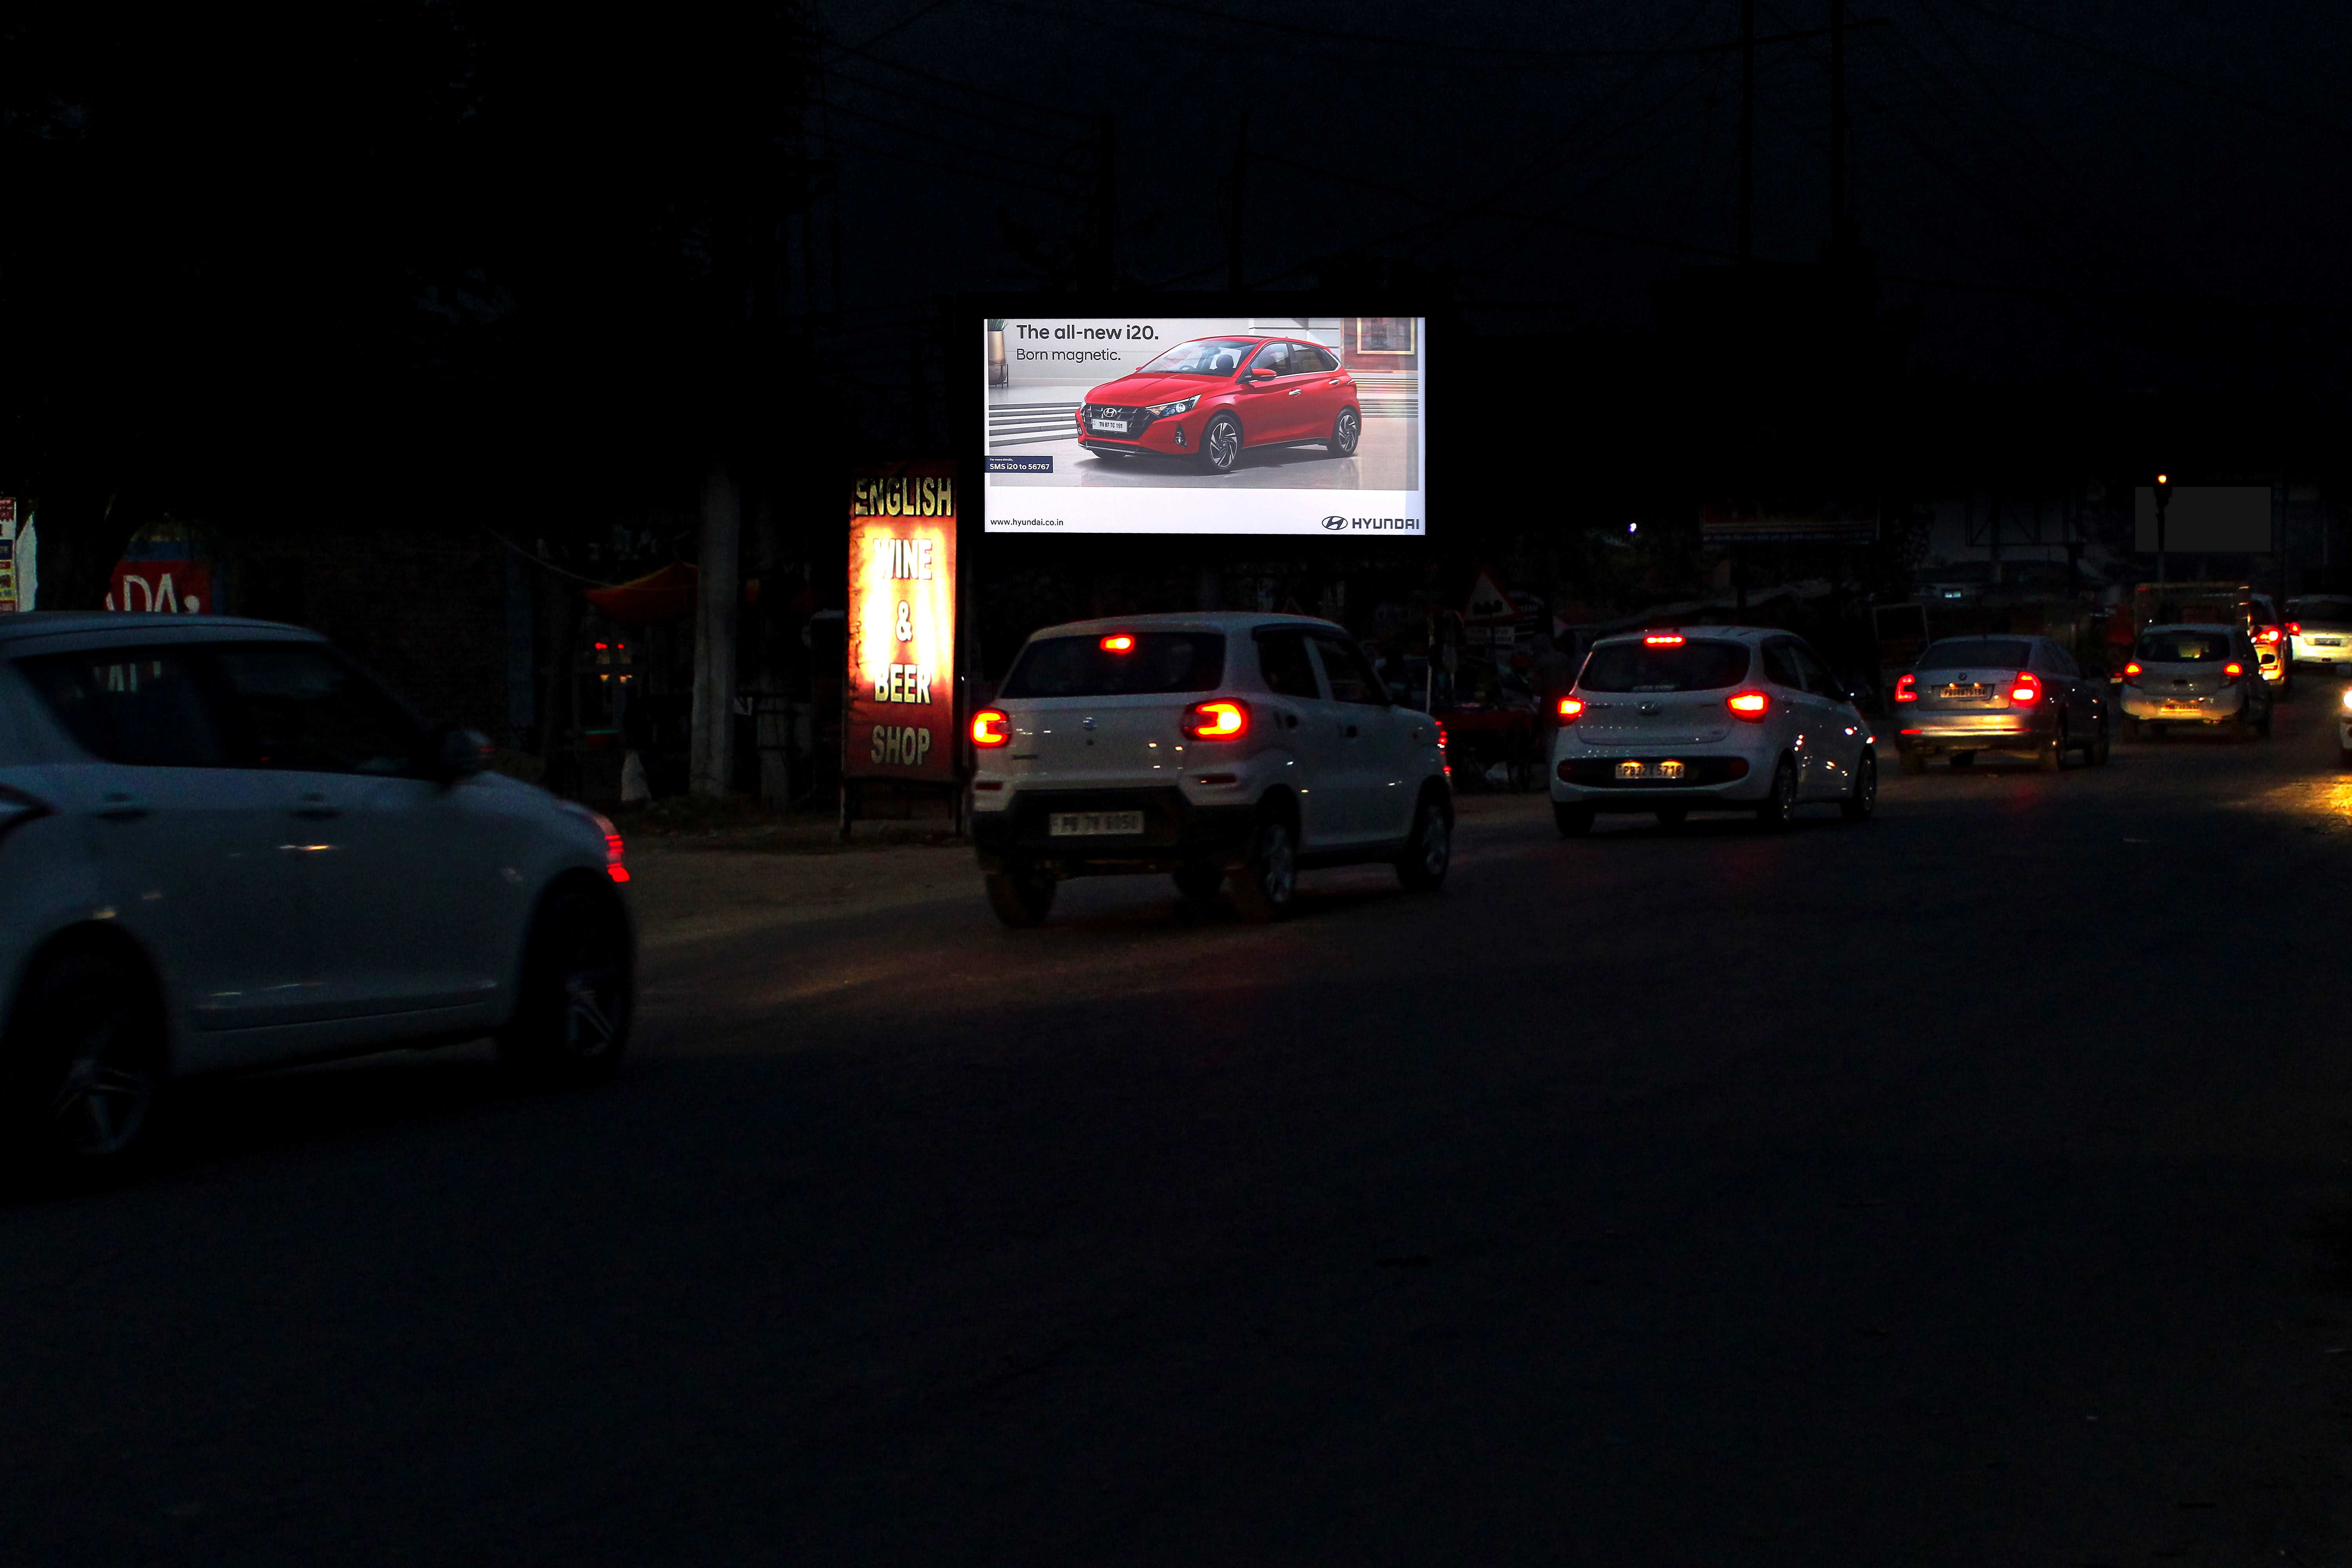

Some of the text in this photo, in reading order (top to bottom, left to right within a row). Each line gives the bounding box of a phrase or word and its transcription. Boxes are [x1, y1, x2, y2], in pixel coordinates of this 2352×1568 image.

[1016, 324, 1159, 340] The all-new i20.
[1016, 348, 1121, 363] Born magnetic.
[855, 477, 951, 516] ENGLISH
[990, 518, 1063, 526] www.hyundai.co.in
[1352, 518, 1419, 529] HYUNDAI
[873, 538, 933, 580] WINE
[895, 600, 913, 642] &
[874, 663, 931, 704] BEER
[871, 725, 930, 765] SHOP
